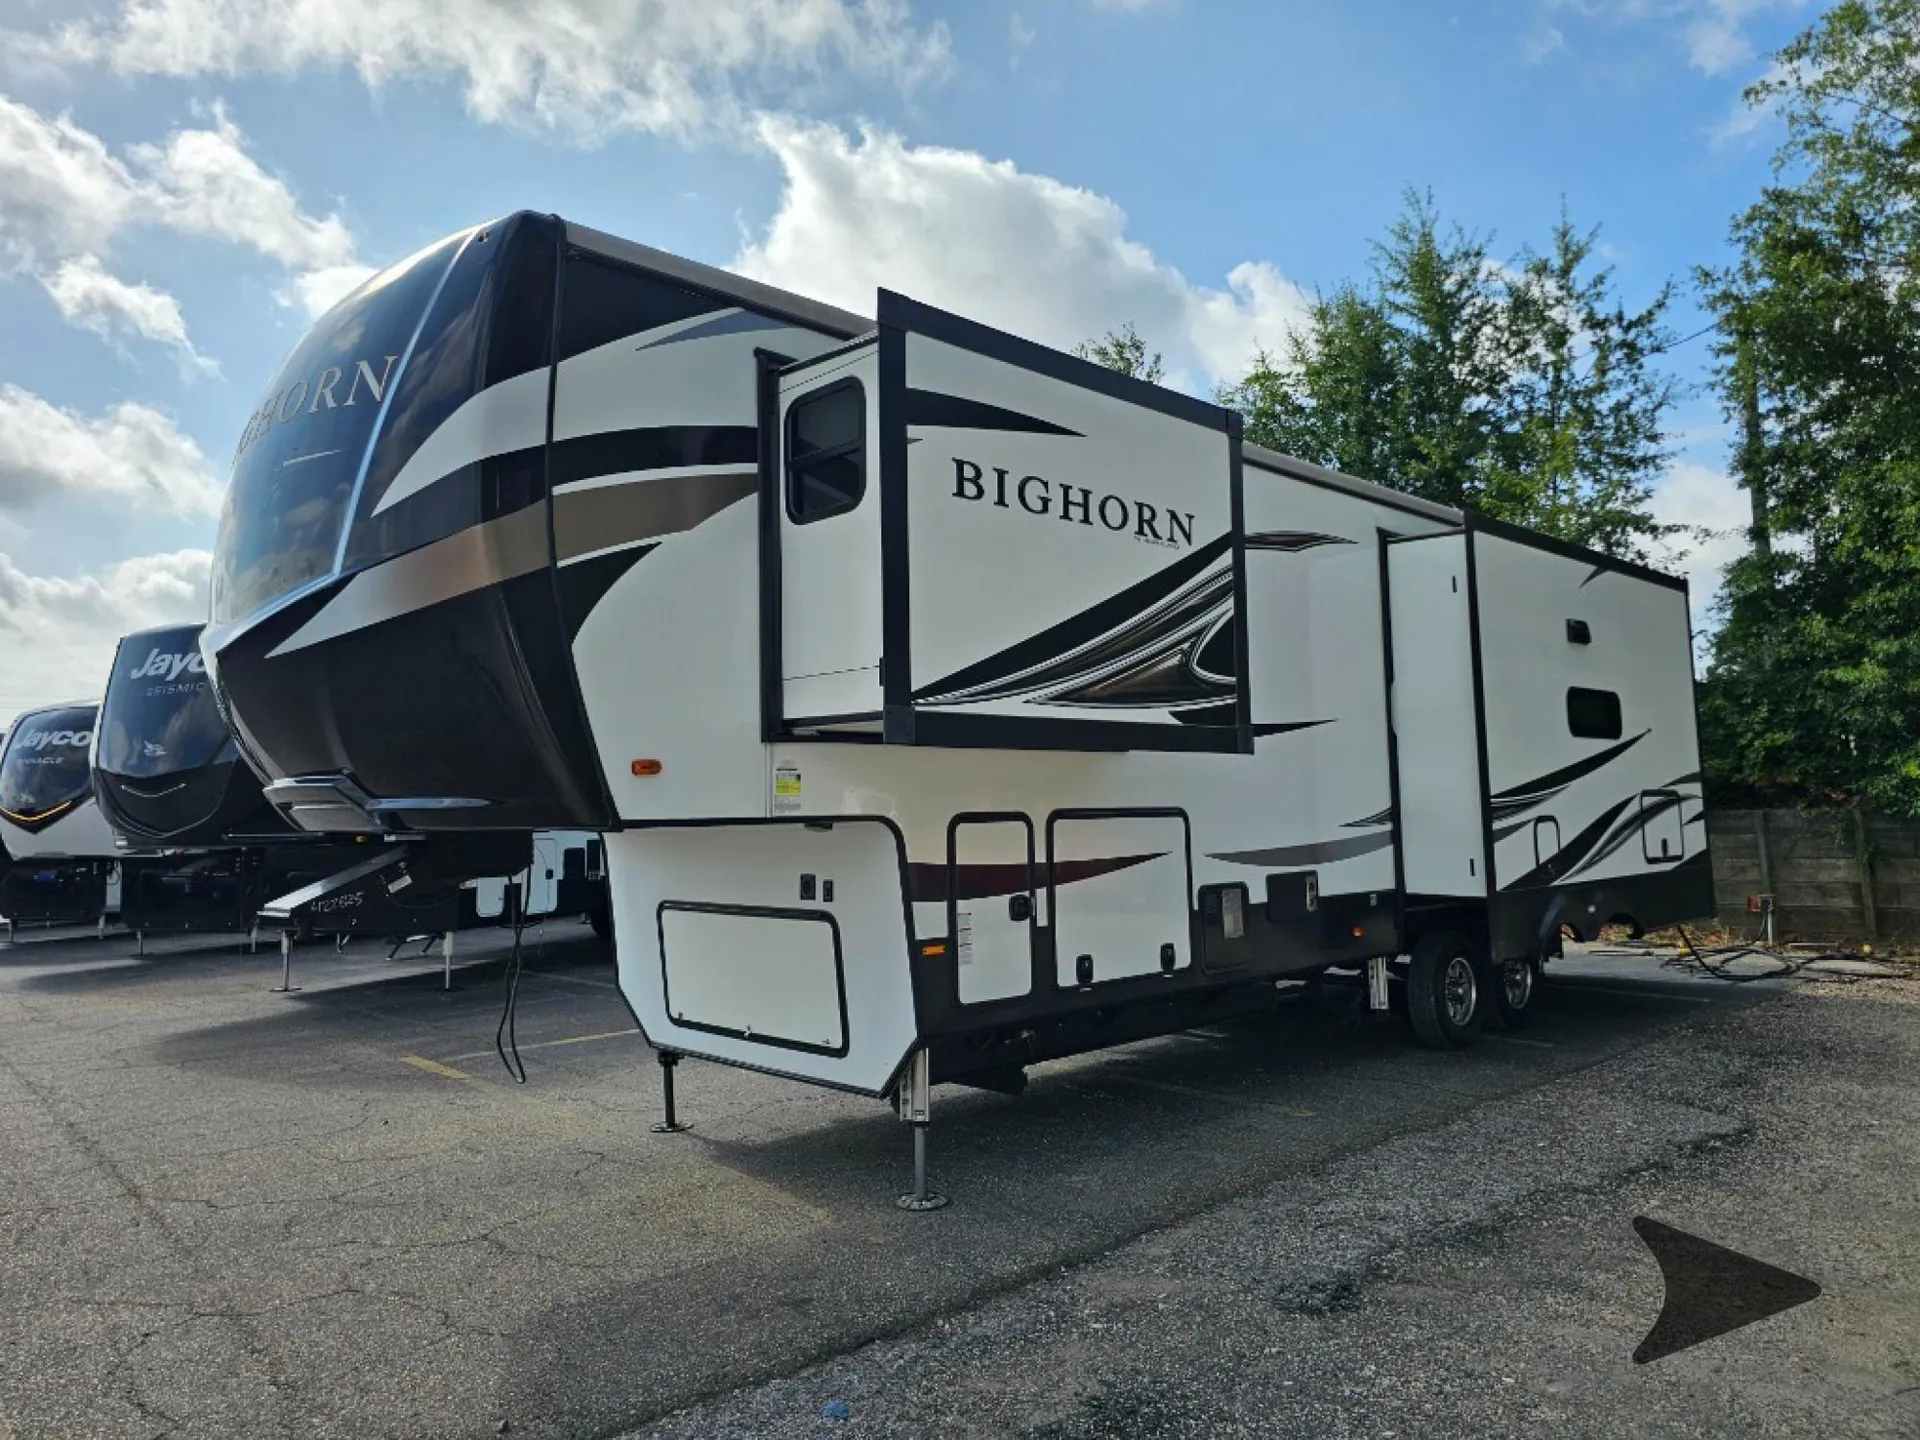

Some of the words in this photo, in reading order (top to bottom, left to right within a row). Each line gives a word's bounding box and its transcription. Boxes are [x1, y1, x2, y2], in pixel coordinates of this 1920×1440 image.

[951, 457, 1195, 546] BIGHORN
[130, 648, 207, 681] Jayc
[15, 729, 93, 751] Jayco
